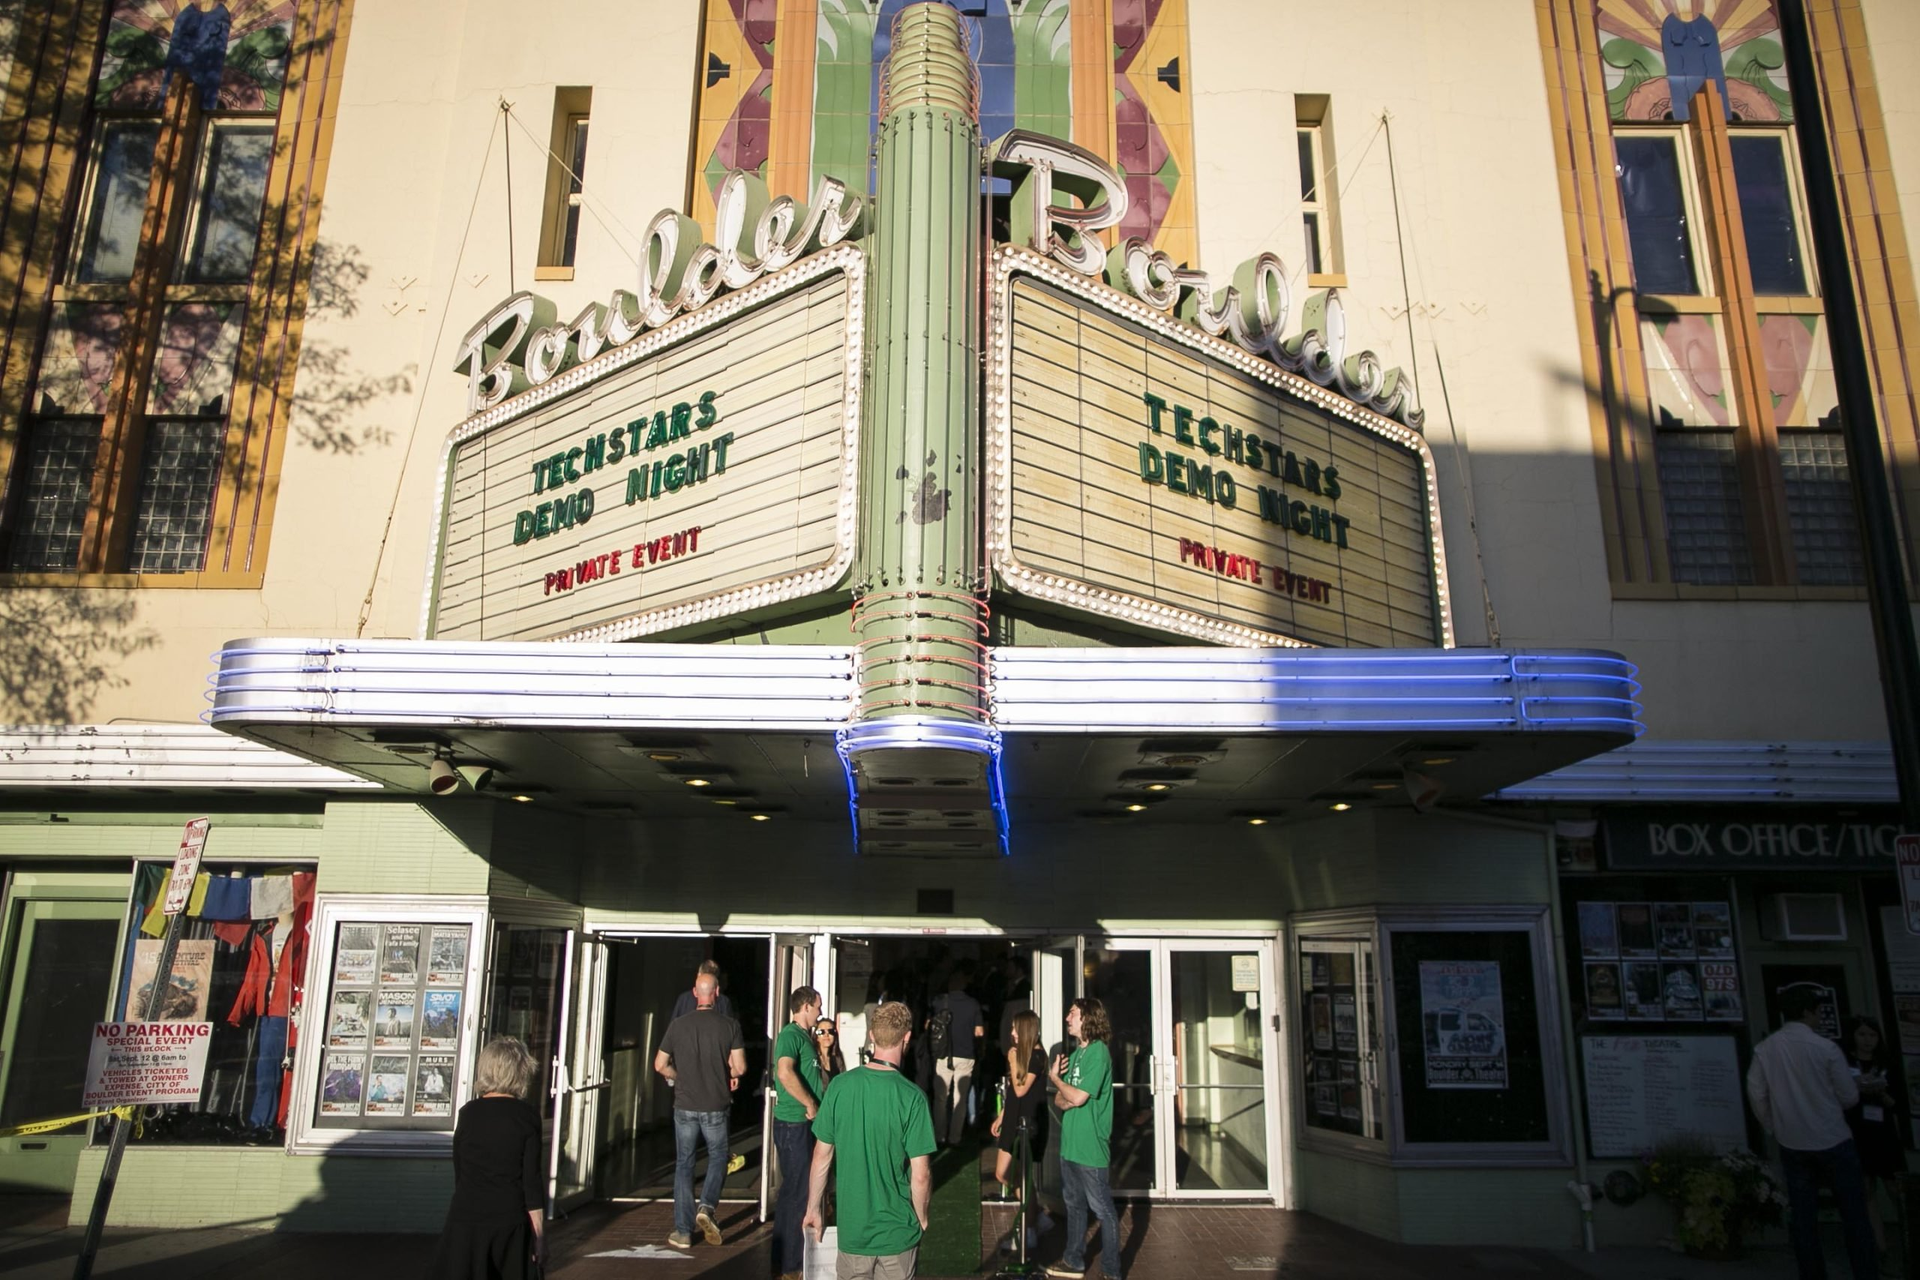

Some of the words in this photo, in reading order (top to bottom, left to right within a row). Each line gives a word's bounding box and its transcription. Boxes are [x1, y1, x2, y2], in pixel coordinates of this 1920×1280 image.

[988, 128, 1424, 430] Boulder
[453, 167, 866, 415] Boulder
[532, 390, 718, 495] TECHSTARS
[1143, 391, 1342, 500] TECHSTARS
[513, 487, 594, 545] DEMO
[625, 432, 734, 504] NIGHT
[1139, 441, 1236, 509] DEMO
[1257, 484, 1350, 549] NIGHT
[544, 550, 620, 595] PRIVATE
[631, 526, 702, 569] EVENT
[1179, 537, 1262, 584] PRIVATE
[1274, 566, 1332, 604] EVENT
[1649, 822, 1716, 856] BOX
[1720, 822, 1907, 858] OFFICE/TIC
[1899, 843, 1920, 863] NO
[1704, 965, 1734, 976] OLD
[379, 992, 415, 1000] MASON
[429, 993, 457, 1002] SAVOY
[95, 1024, 124, 1038] NO
[126, 1023, 210, 1038] PARKING
[107, 1037, 151, 1046] SPECIAL
[155, 1036, 195, 1045] EVENT
[151, 1054, 160, 1062] @
[102, 1068, 142, 1077] VEHICLES
[145, 1067, 189, 1075] TICKETED
[108, 1076, 137, 1084] TOWED
[139, 1075, 150, 1083] AT
[151, 1074, 190, 1082] OWNERS
[85, 1090, 124, 1100] BOULDER
[125, 1089, 154, 1097] EVENT
